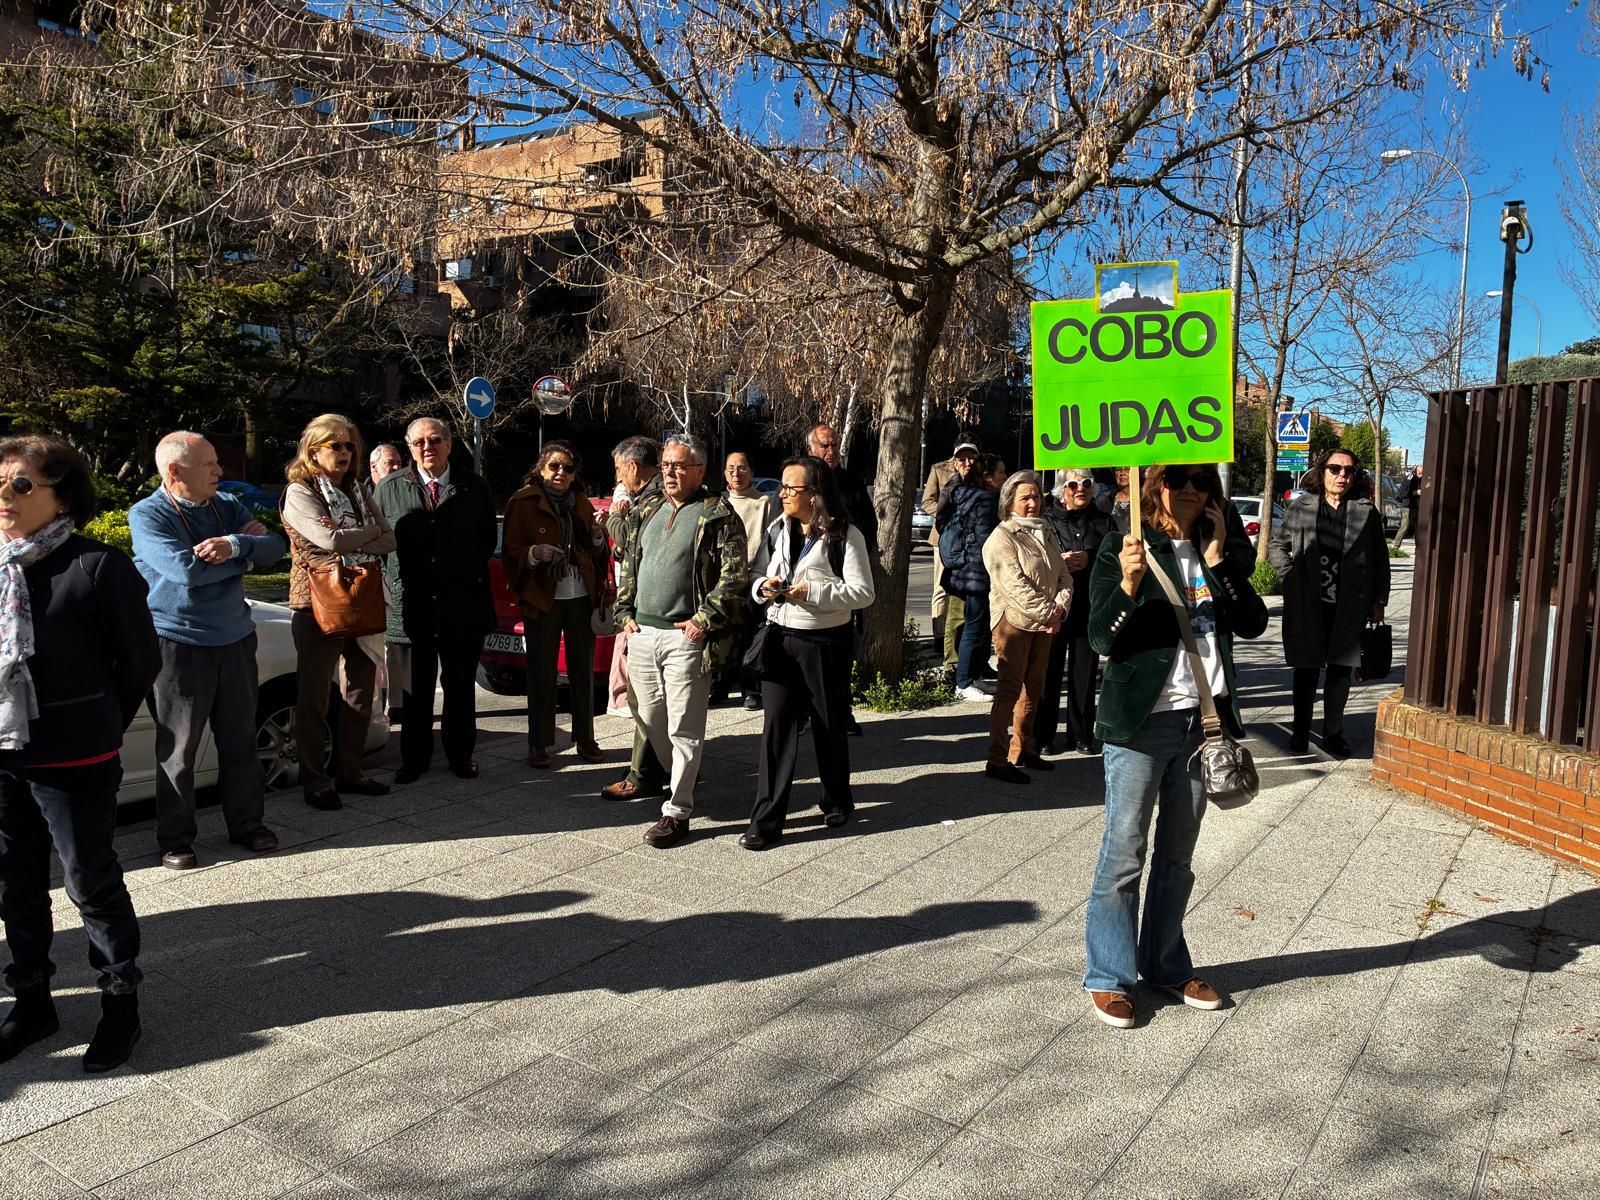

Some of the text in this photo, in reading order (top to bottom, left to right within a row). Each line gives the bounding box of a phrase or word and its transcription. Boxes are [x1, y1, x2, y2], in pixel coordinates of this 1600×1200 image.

[1048, 311, 1217, 364] COBO
[1040, 396, 1223, 451] JUDAS
[487, 634, 511, 649] 4769
